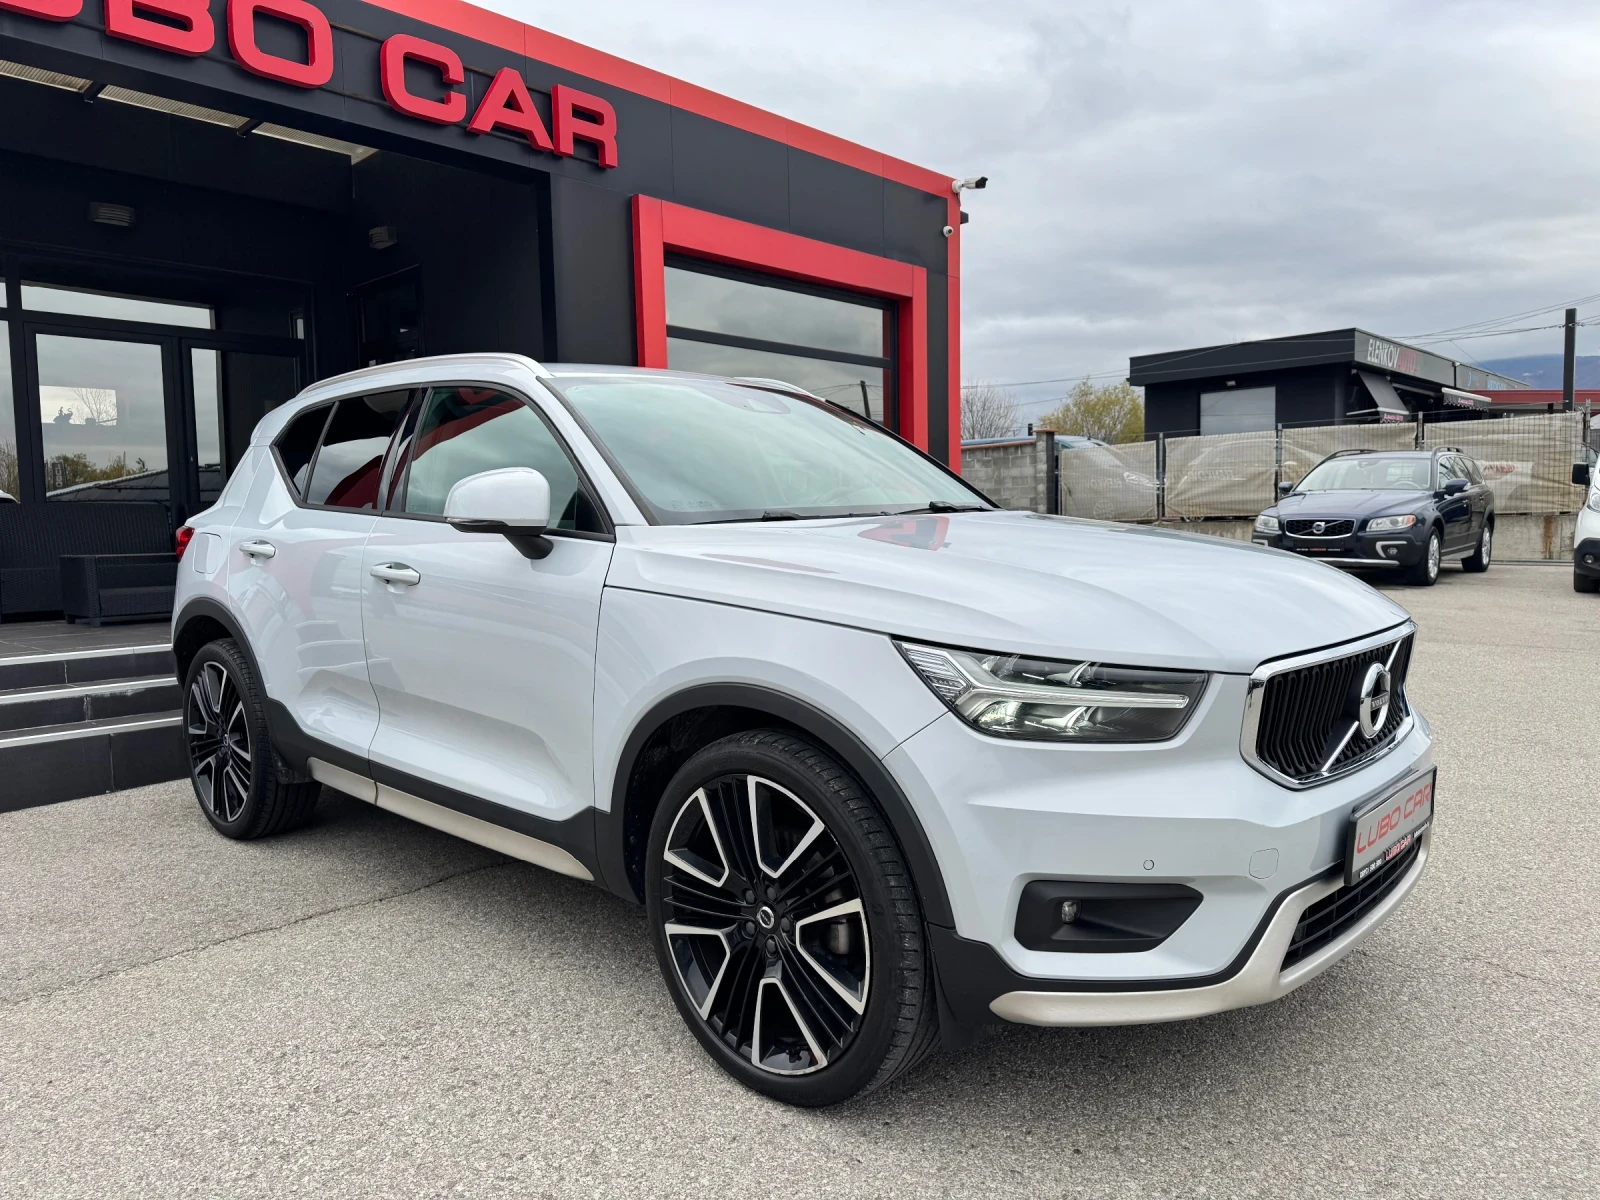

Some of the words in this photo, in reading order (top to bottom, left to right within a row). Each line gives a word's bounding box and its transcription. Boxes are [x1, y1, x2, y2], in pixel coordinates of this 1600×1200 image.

[0, 0, 333, 88] BO
[380, 33, 618, 169] CAR
[1356, 805, 1401, 854] LUBO
[1403, 782, 1432, 819] CAR
